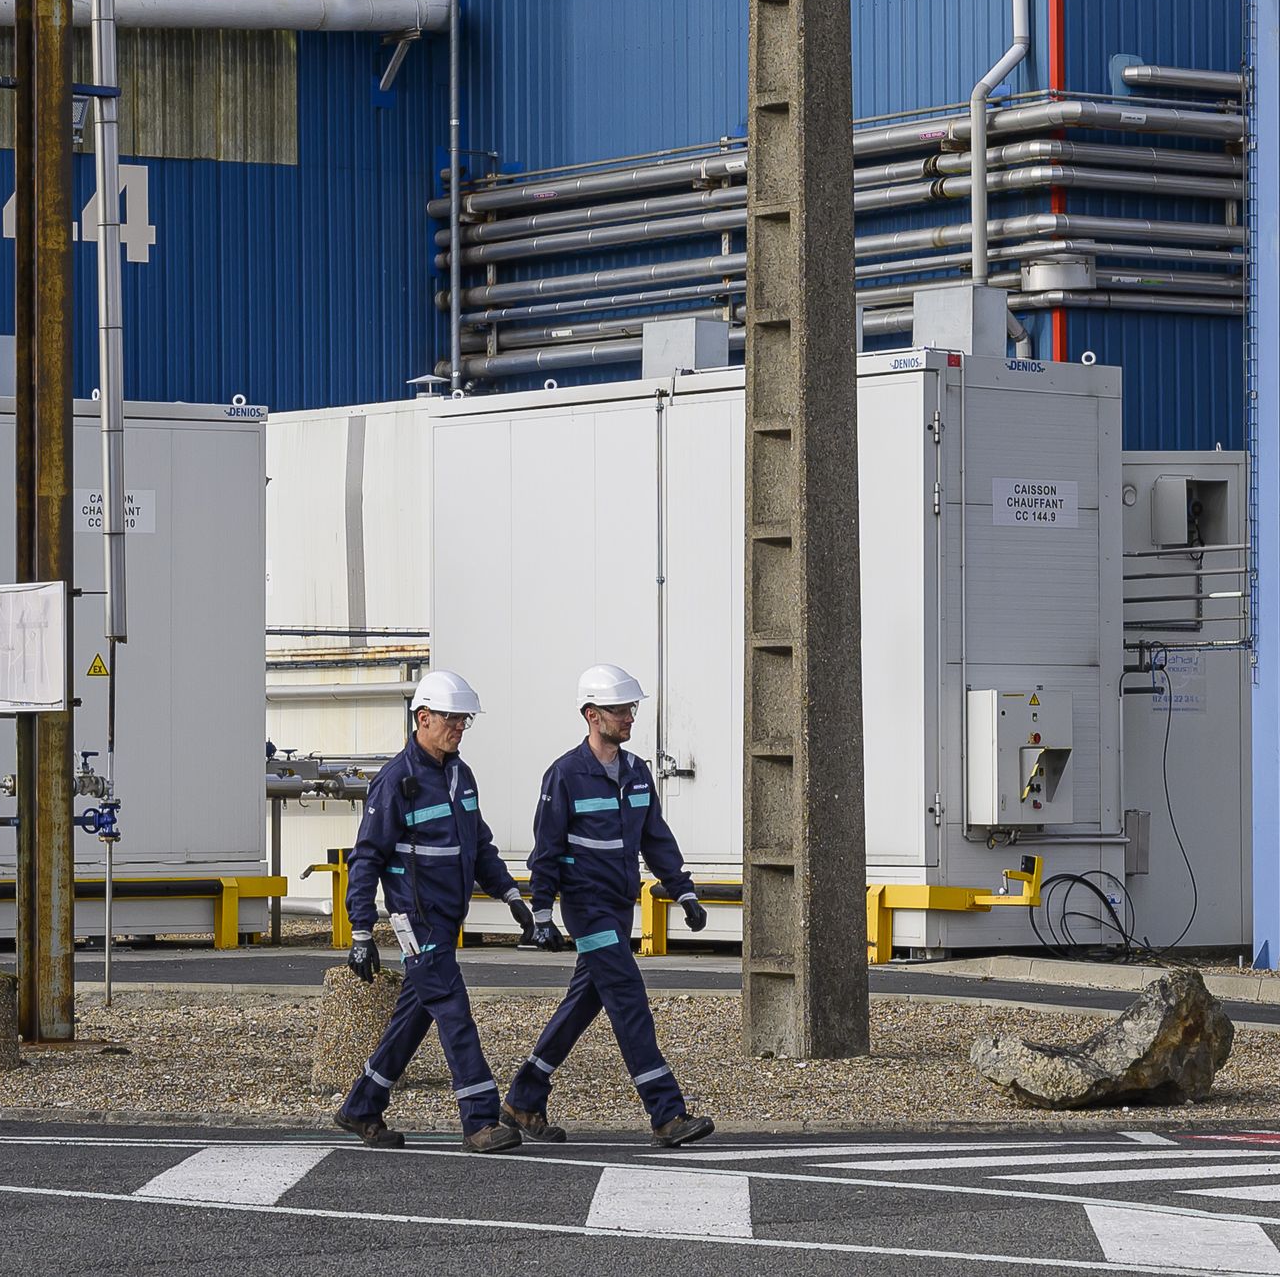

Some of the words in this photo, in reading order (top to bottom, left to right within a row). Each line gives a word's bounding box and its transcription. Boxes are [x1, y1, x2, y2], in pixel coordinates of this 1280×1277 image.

[894, 358, 920, 370] DENIOS
[1009, 360, 1042, 373] DENIOS
[229, 407, 261, 418] DENIOS
[1014, 484, 1057, 495] CAISSON
[1007, 497, 1064, 509] CHAUFFANT
[1015, 510, 1028, 520] CC
[1032, 511, 1056, 522] 144.9
[88, 518, 101, 527] CC
[93, 665, 103, 674] EX
